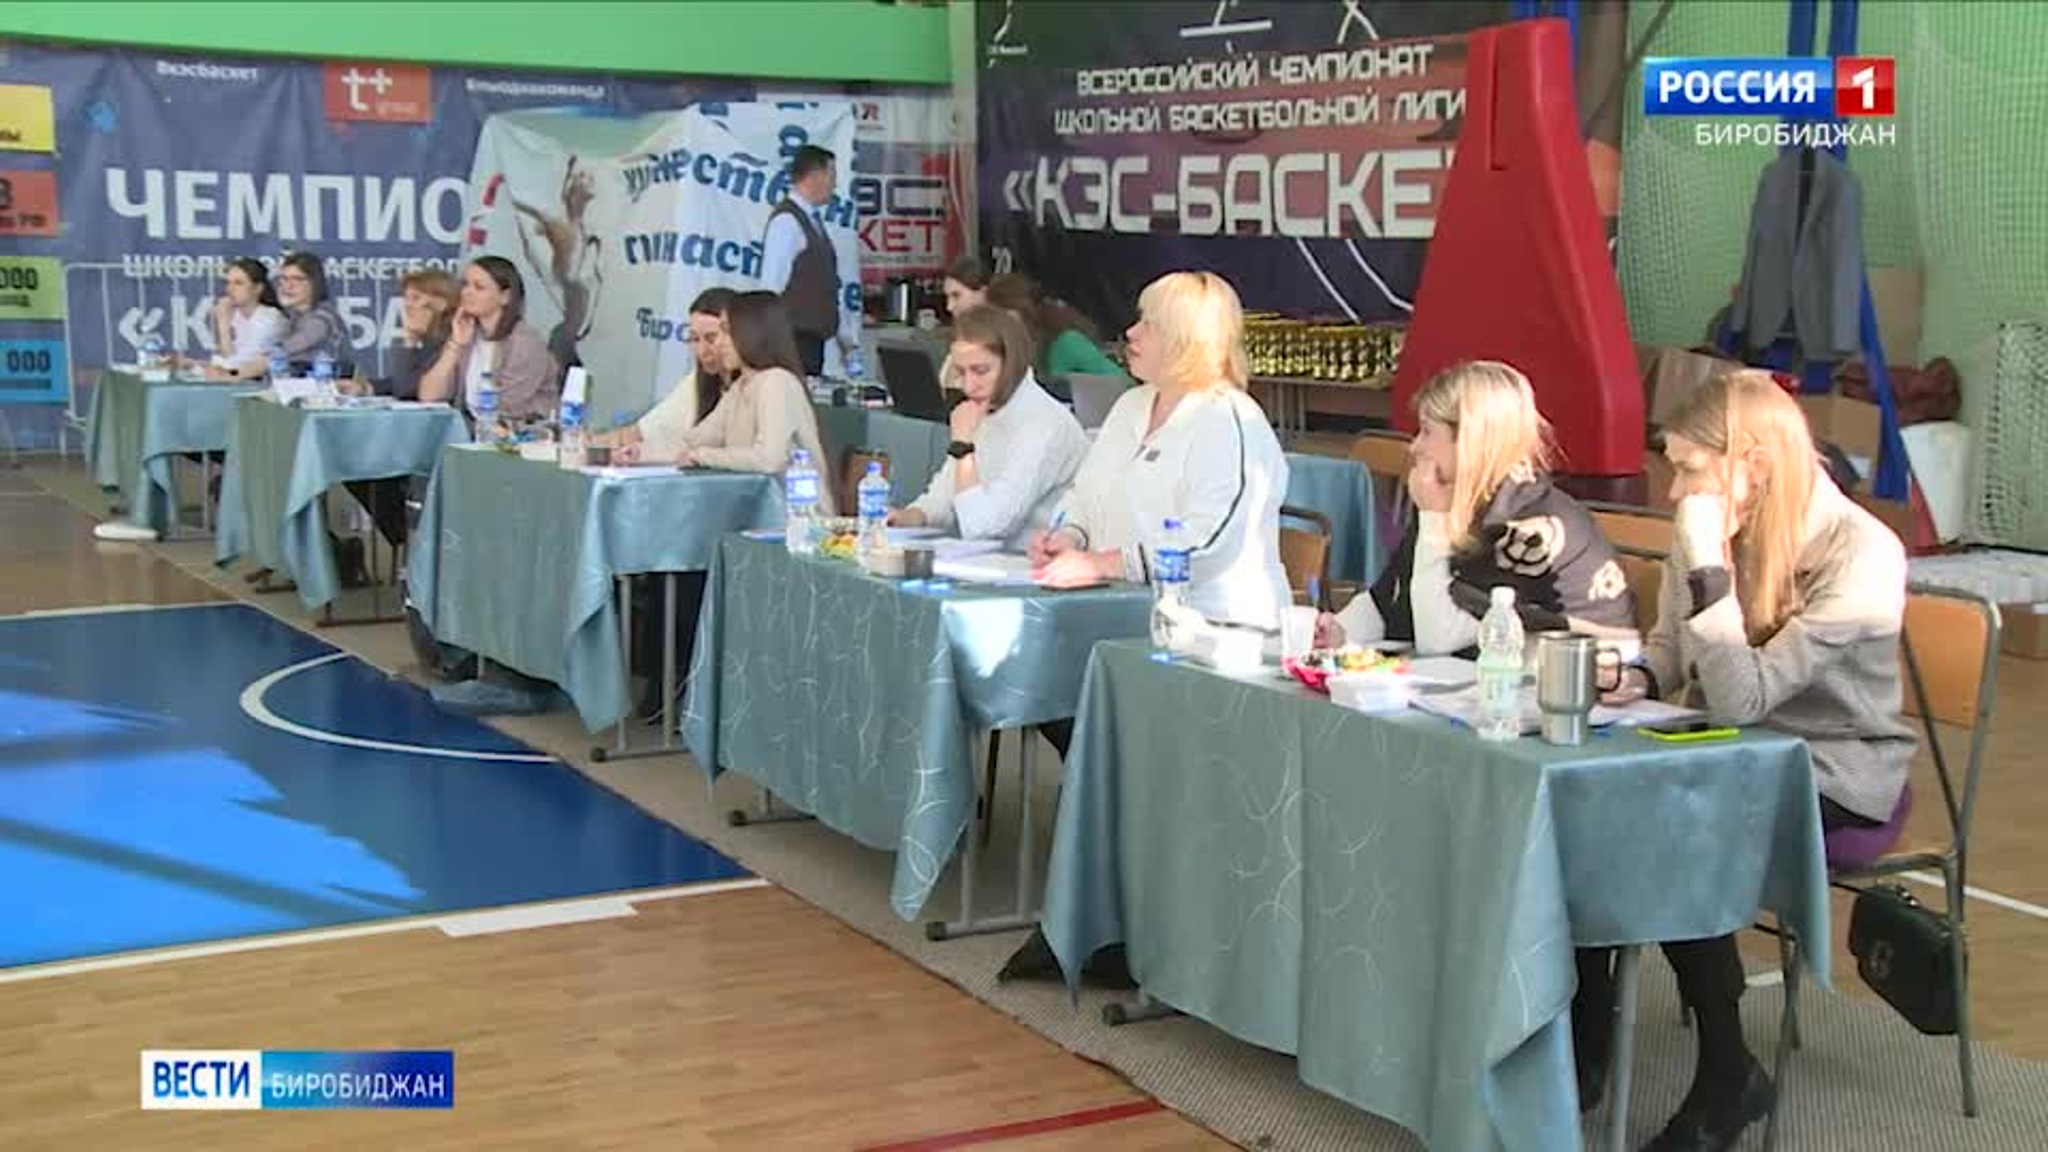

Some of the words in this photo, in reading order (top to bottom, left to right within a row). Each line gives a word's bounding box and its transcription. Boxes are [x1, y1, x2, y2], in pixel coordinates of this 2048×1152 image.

[1077, 50, 1259, 97] ВСЕРОССИЙСКИЙ
[1270, 44, 1434, 84] ЧЕМПИОНАТ
[1055, 100, 1162, 135] ШКОЛЬНОЙ
[1169, 87, 1379, 132] БАСКЕТБОЛЬНОЙ
[1393, 87, 1466, 120] ЛИГИ
[106, 168, 467, 244] ЧЕМПИО
[1004, 148, 1456, 239] «КЭС-БАСКЕ
